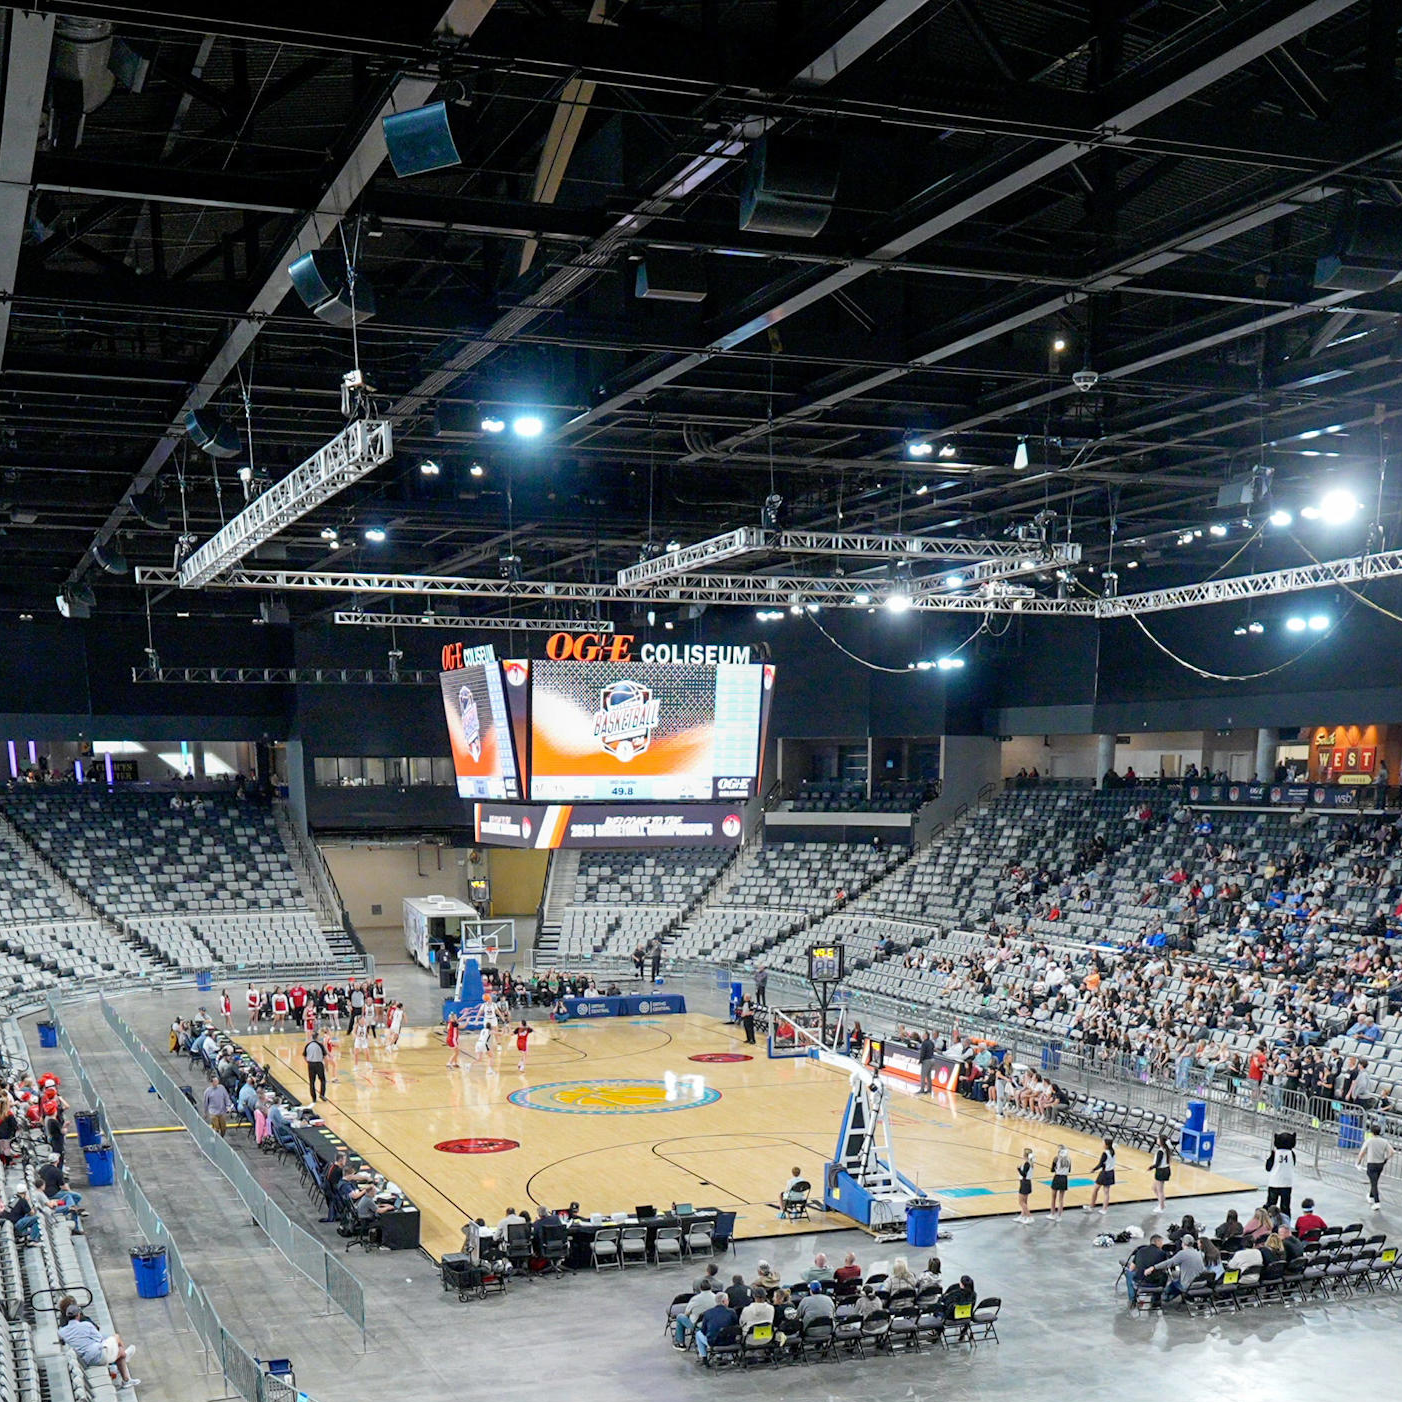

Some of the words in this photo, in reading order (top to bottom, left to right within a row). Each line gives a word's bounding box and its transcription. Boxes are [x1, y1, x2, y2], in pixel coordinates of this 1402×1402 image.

[641, 643, 751, 665] COLISEUM
[593, 703, 659, 737] BASKETBALL
[1319, 752, 1372, 767] WEST
[611, 787, 634, 796] 49.8
[1278, 1155, 1288, 1163] 34
